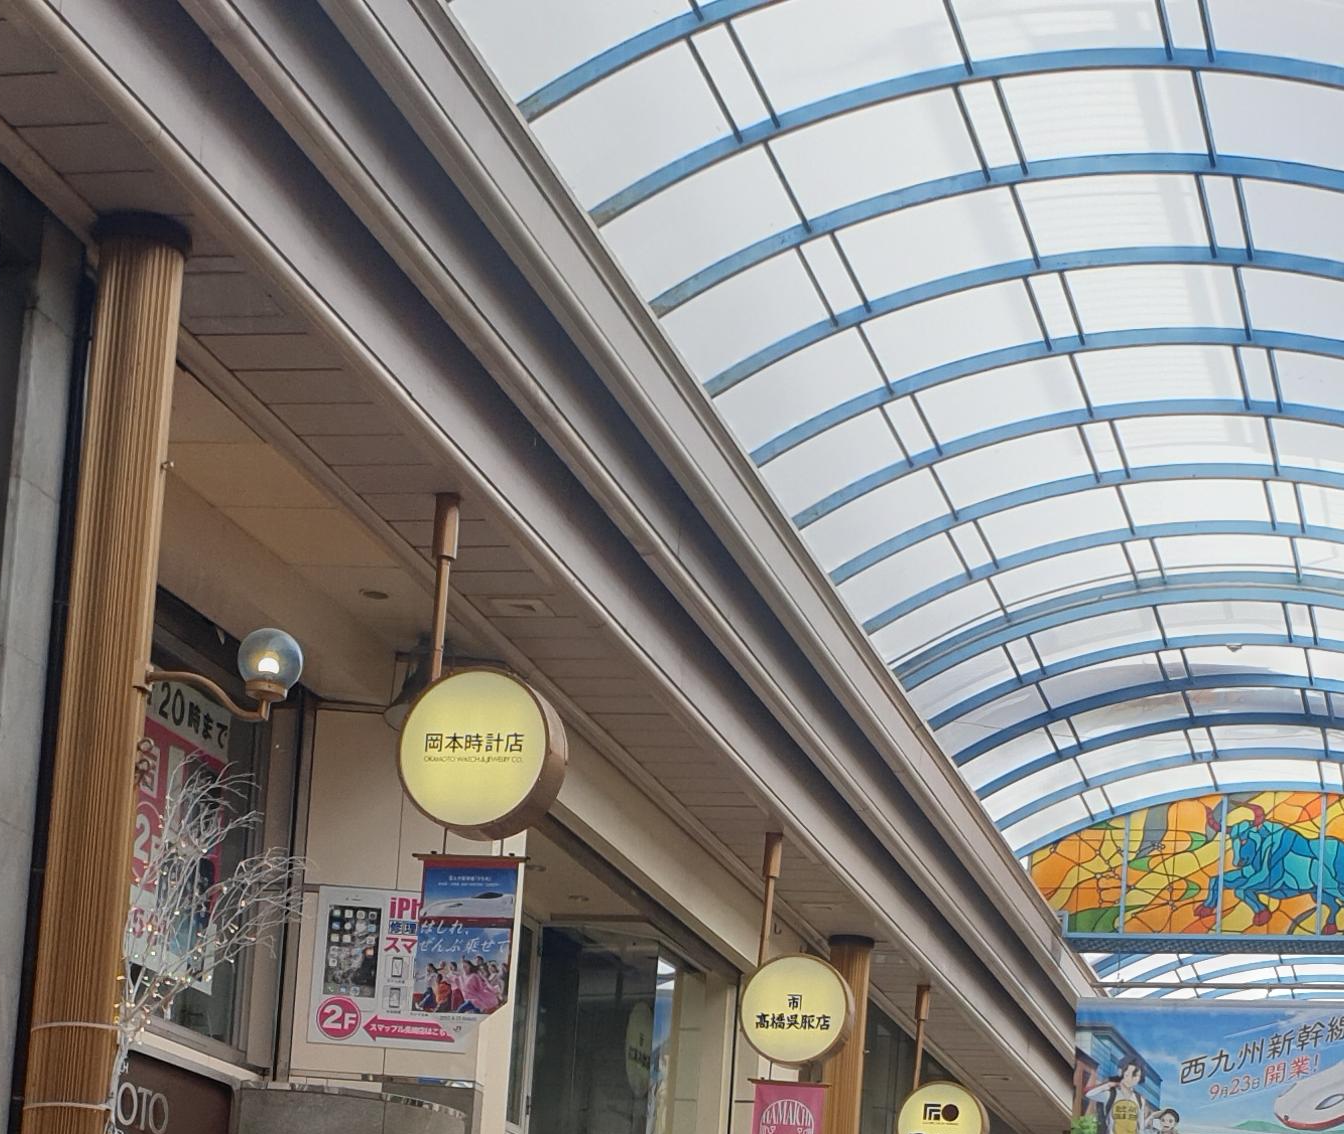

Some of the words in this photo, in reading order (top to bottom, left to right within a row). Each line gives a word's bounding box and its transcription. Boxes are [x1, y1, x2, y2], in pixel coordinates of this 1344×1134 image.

[424, 733, 525, 753] 岡本時計店
[322, 1004, 357, 1031] 2F
